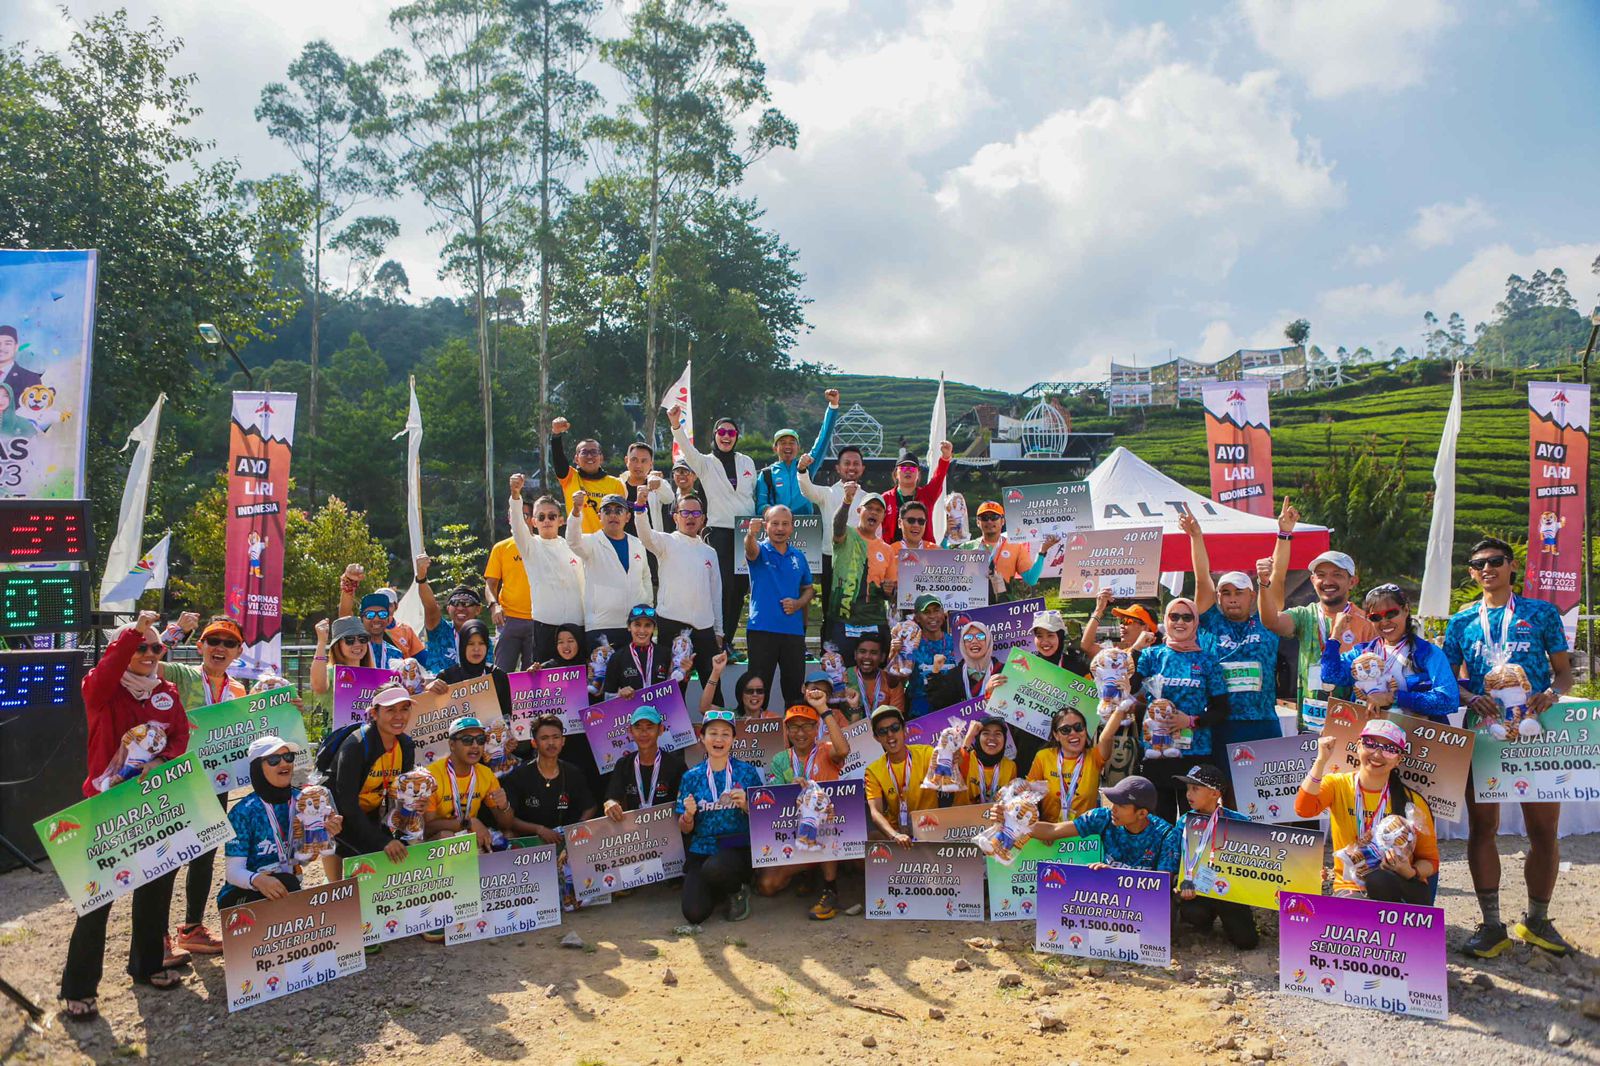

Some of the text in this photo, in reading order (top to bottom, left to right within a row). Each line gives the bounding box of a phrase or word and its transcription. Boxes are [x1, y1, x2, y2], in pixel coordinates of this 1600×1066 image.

[1217, 446, 1245, 460] AYO
[1536, 443, 1563, 459] AYO
[238, 458, 267, 474] AYO
[1543, 465, 1571, 479] LARI
[1224, 466, 1255, 480] LARI
[245, 481, 274, 496] LARI
[1056, 484, 1086, 495] 20 KM
[1220, 486, 1262, 501] INDONESIA
[1027, 498, 1068, 509] JUARA 3
[1103, 501, 1218, 519] ALTI
[802, 519, 818, 527] KM
[1123, 531, 1158, 542] 40 KM
[953, 554, 985, 562] 40 KM
[1089, 547, 1125, 558] JUARA
[922, 566, 956, 574] JUARA
[1539, 571, 1577, 579] FORNAS
[248, 594, 278, 604] FORNAS
[954, 601, 968, 610] bjb
[260, 603, 277, 611] 2023
[1008, 602, 1039, 616] 10 KM
[1016, 620, 1022, 629] 3
[388, 675, 400, 683] 10
[547, 672, 561, 683] 10
[554, 687, 562, 697] 2
[1069, 679, 1085, 693] 20
[451, 687, 467, 699] 40
[641, 692, 654, 703] 10
[249, 700, 266, 713] 20
[463, 702, 470, 712] 3
[1069, 696, 1080, 707] 2
[1564, 708, 1587, 722] 20
[206, 716, 268, 743] JUARA 3
[744, 722, 779, 733] 40 KM
[1413, 726, 1436, 740] 40
[1578, 729, 1588, 742] 3
[199, 737, 245, 758] MASTER
[1418, 746, 1429, 758] 3
[1500, 747, 1550, 759] SENIOR
[203, 759, 221, 771] Rp.
[1501, 762, 1522, 774] Rp.
[140, 759, 193, 795] 20 KM
[1254, 774, 1296, 787] MASTER
[836, 784, 856, 796] KM
[1479, 787, 1600, 801] KORMI bank bjb
[1427, 795, 1457, 808] FORNAS
[93, 794, 170, 842] JUARA 2
[634, 814, 651, 825] 40
[86, 803, 185, 860] MASTER PUTRI
[196, 821, 226, 839] FORNAS
[1269, 830, 1287, 843] 10
[599, 831, 640, 850] JUARA
[627, 839, 659, 854] PUTRA
[427, 846, 445, 860] 20
[937, 847, 978, 858] 40 KM
[1058, 842, 1075, 853] 20
[514, 854, 530, 866] 40
[755, 856, 778, 865] KORMI
[1276, 849, 1288, 861] 2
[96, 854, 121, 871] Rp.
[594, 863, 610, 873] Rp.
[896, 863, 953, 874] JUARA 3
[1219, 852, 1282, 872] KELUARGA
[81, 889, 113, 910] KORMI
[142, 854, 177, 881] bank
[177, 842, 202, 865] bjb
[384, 868, 433, 889] JUARA
[521, 871, 529, 883] 2
[888, 876, 961, 885] SENIOR PUTRA
[372, 876, 454, 903] MASTER PUTRI
[622, 877, 646, 889] bank
[1117, 875, 1161, 891] 10 KM
[507, 883, 540, 897] PUTRA
[888, 886, 904, 897] Rp.
[309, 891, 328, 907] 40
[1070, 890, 1120, 907] JUARA
[376, 904, 394, 916] Rp.
[454, 901, 478, 910] FORNAS
[1061, 904, 1144, 922] SENIOR PUTRA
[1289, 915, 1309, 923] ALTI
[1378, 909, 1434, 929] 10 KM
[263, 915, 314, 941] JUARA
[405, 920, 432, 934] bank
[434, 914, 454, 929] bjb
[494, 923, 518, 935] bank
[519, 919, 536, 931] bjb
[1061, 916, 1078, 930] Rp.
[233, 927, 251, 936] ALTI
[1320, 925, 1382, 946] JUARA
[251, 925, 337, 959] MASTER PUTRI
[1140, 943, 1167, 952] FORNAS
[337, 950, 362, 963] FORNAS
[1040, 942, 1064, 951] KORMI
[1089, 945, 1116, 958] bank
[1118, 949, 1139, 962] bjb
[1309, 940, 1407, 964] SENIOR PUTRI
[256, 959, 275, 972] Rp.
[338, 960, 347, 968] VII
[1309, 954, 1330, 970] Rp.
[232, 992, 261, 1007] KORMI
[286, 975, 314, 993] bank
[316, 968, 336, 983] bjb
[1284, 983, 1407, 1013] KORMI bank bjb
[1408, 990, 1443, 1002] FORNAS
[1422, 999, 1442, 1009] 2023
